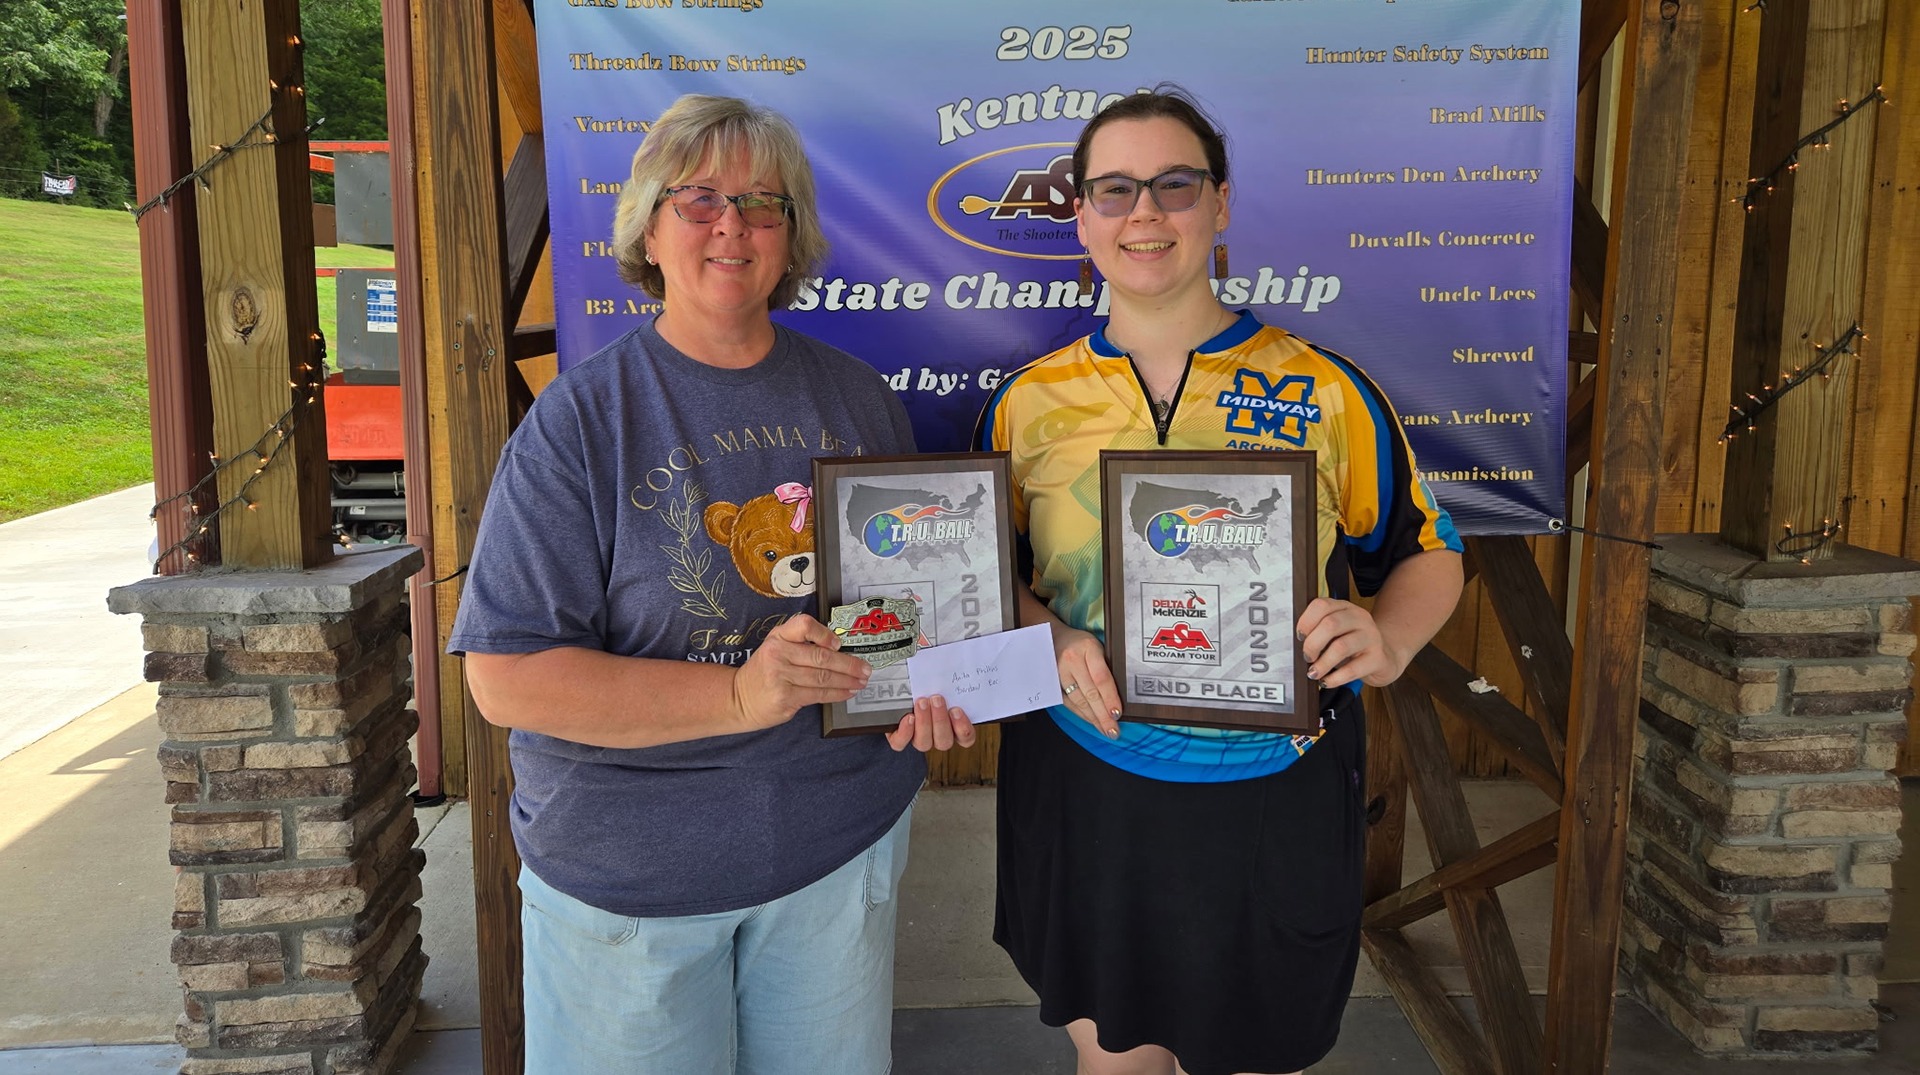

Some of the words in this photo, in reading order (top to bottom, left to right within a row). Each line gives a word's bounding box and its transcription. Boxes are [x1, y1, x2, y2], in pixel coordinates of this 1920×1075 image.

[996, 24, 1132, 61] 2025
[569, 52, 662, 71] Threadz
[669, 54, 721, 72] Bow
[726, 54, 807, 75] Strings
[1305, 46, 1387, 64] Hunter
[1392, 44, 1464, 64] Safety
[1469, 44, 1549, 65] System
[573, 116, 652, 133] Vortex
[1429, 106, 1483, 124] Brad
[1489, 104, 1546, 123] Mills
[1305, 168, 1396, 185] Hunters
[1401, 166, 1446, 184] Den
[1452, 164, 1543, 184] Archery
[997, 229, 1019, 241] The
[1023, 228, 1078, 240] Shooters
[1349, 230, 1432, 249] Duvalls
[1438, 230, 1536, 248] Concrete
[789, 276, 931, 311] State
[1420, 285, 1482, 303] Uncle
[1489, 285, 1537, 302] Lees
[585, 299, 615, 315] B3
[1452, 346, 1535, 364] Shrewd
[917, 367, 969, 396] by:
[1221, 394, 1319, 418] MIDWAY
[1446, 408, 1533, 427] Archery
[631, 444, 710, 510] COOL
[713, 426, 807, 455] MAMA
[891, 522, 931, 543] T.R.U.
[934, 520, 972, 541] BALL
[1175, 524, 1218, 544] T.R.U.
[1221, 524, 1264, 545] BALL
[1152, 608, 1207, 618] McKENZIE
[1153, 599, 1184, 609] DELTA
[847, 608, 905, 637] ASA
[1249, 582, 1269, 673] 2025
[1147, 621, 1216, 651] ASA
[1147, 650, 1186, 659] PRO/AM
[1189, 652, 1216, 661] TOUR
[1142, 680, 1191, 694] 2ND
[1201, 683, 1277, 700] PLACE
